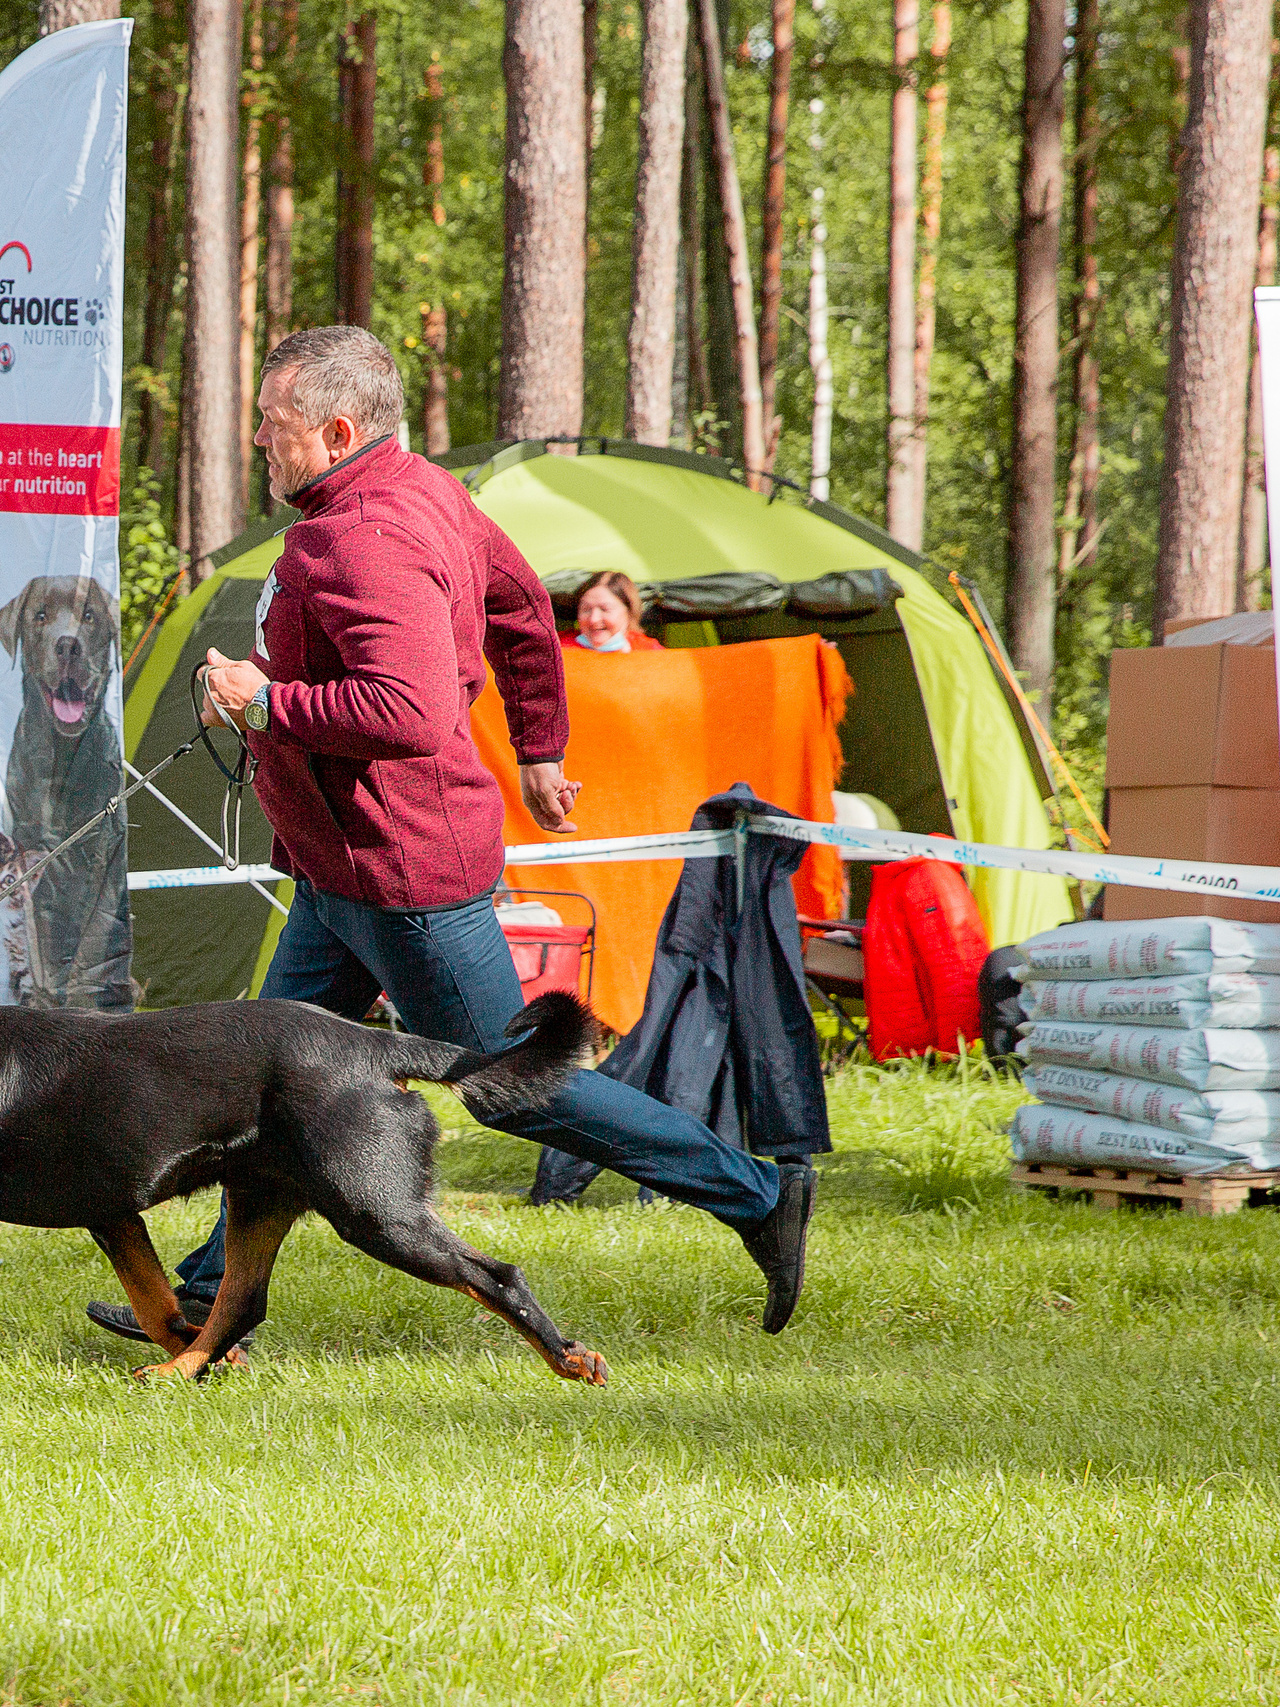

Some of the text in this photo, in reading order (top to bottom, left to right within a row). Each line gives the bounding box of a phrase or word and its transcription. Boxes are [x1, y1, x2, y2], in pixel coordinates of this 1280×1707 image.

[23, 329, 104, 346] NUTRITION
[7, 448, 23, 466] at
[28, 447, 54, 467] the
[57, 448, 103, 468] heart
[13, 475, 87, 495] nutrition
